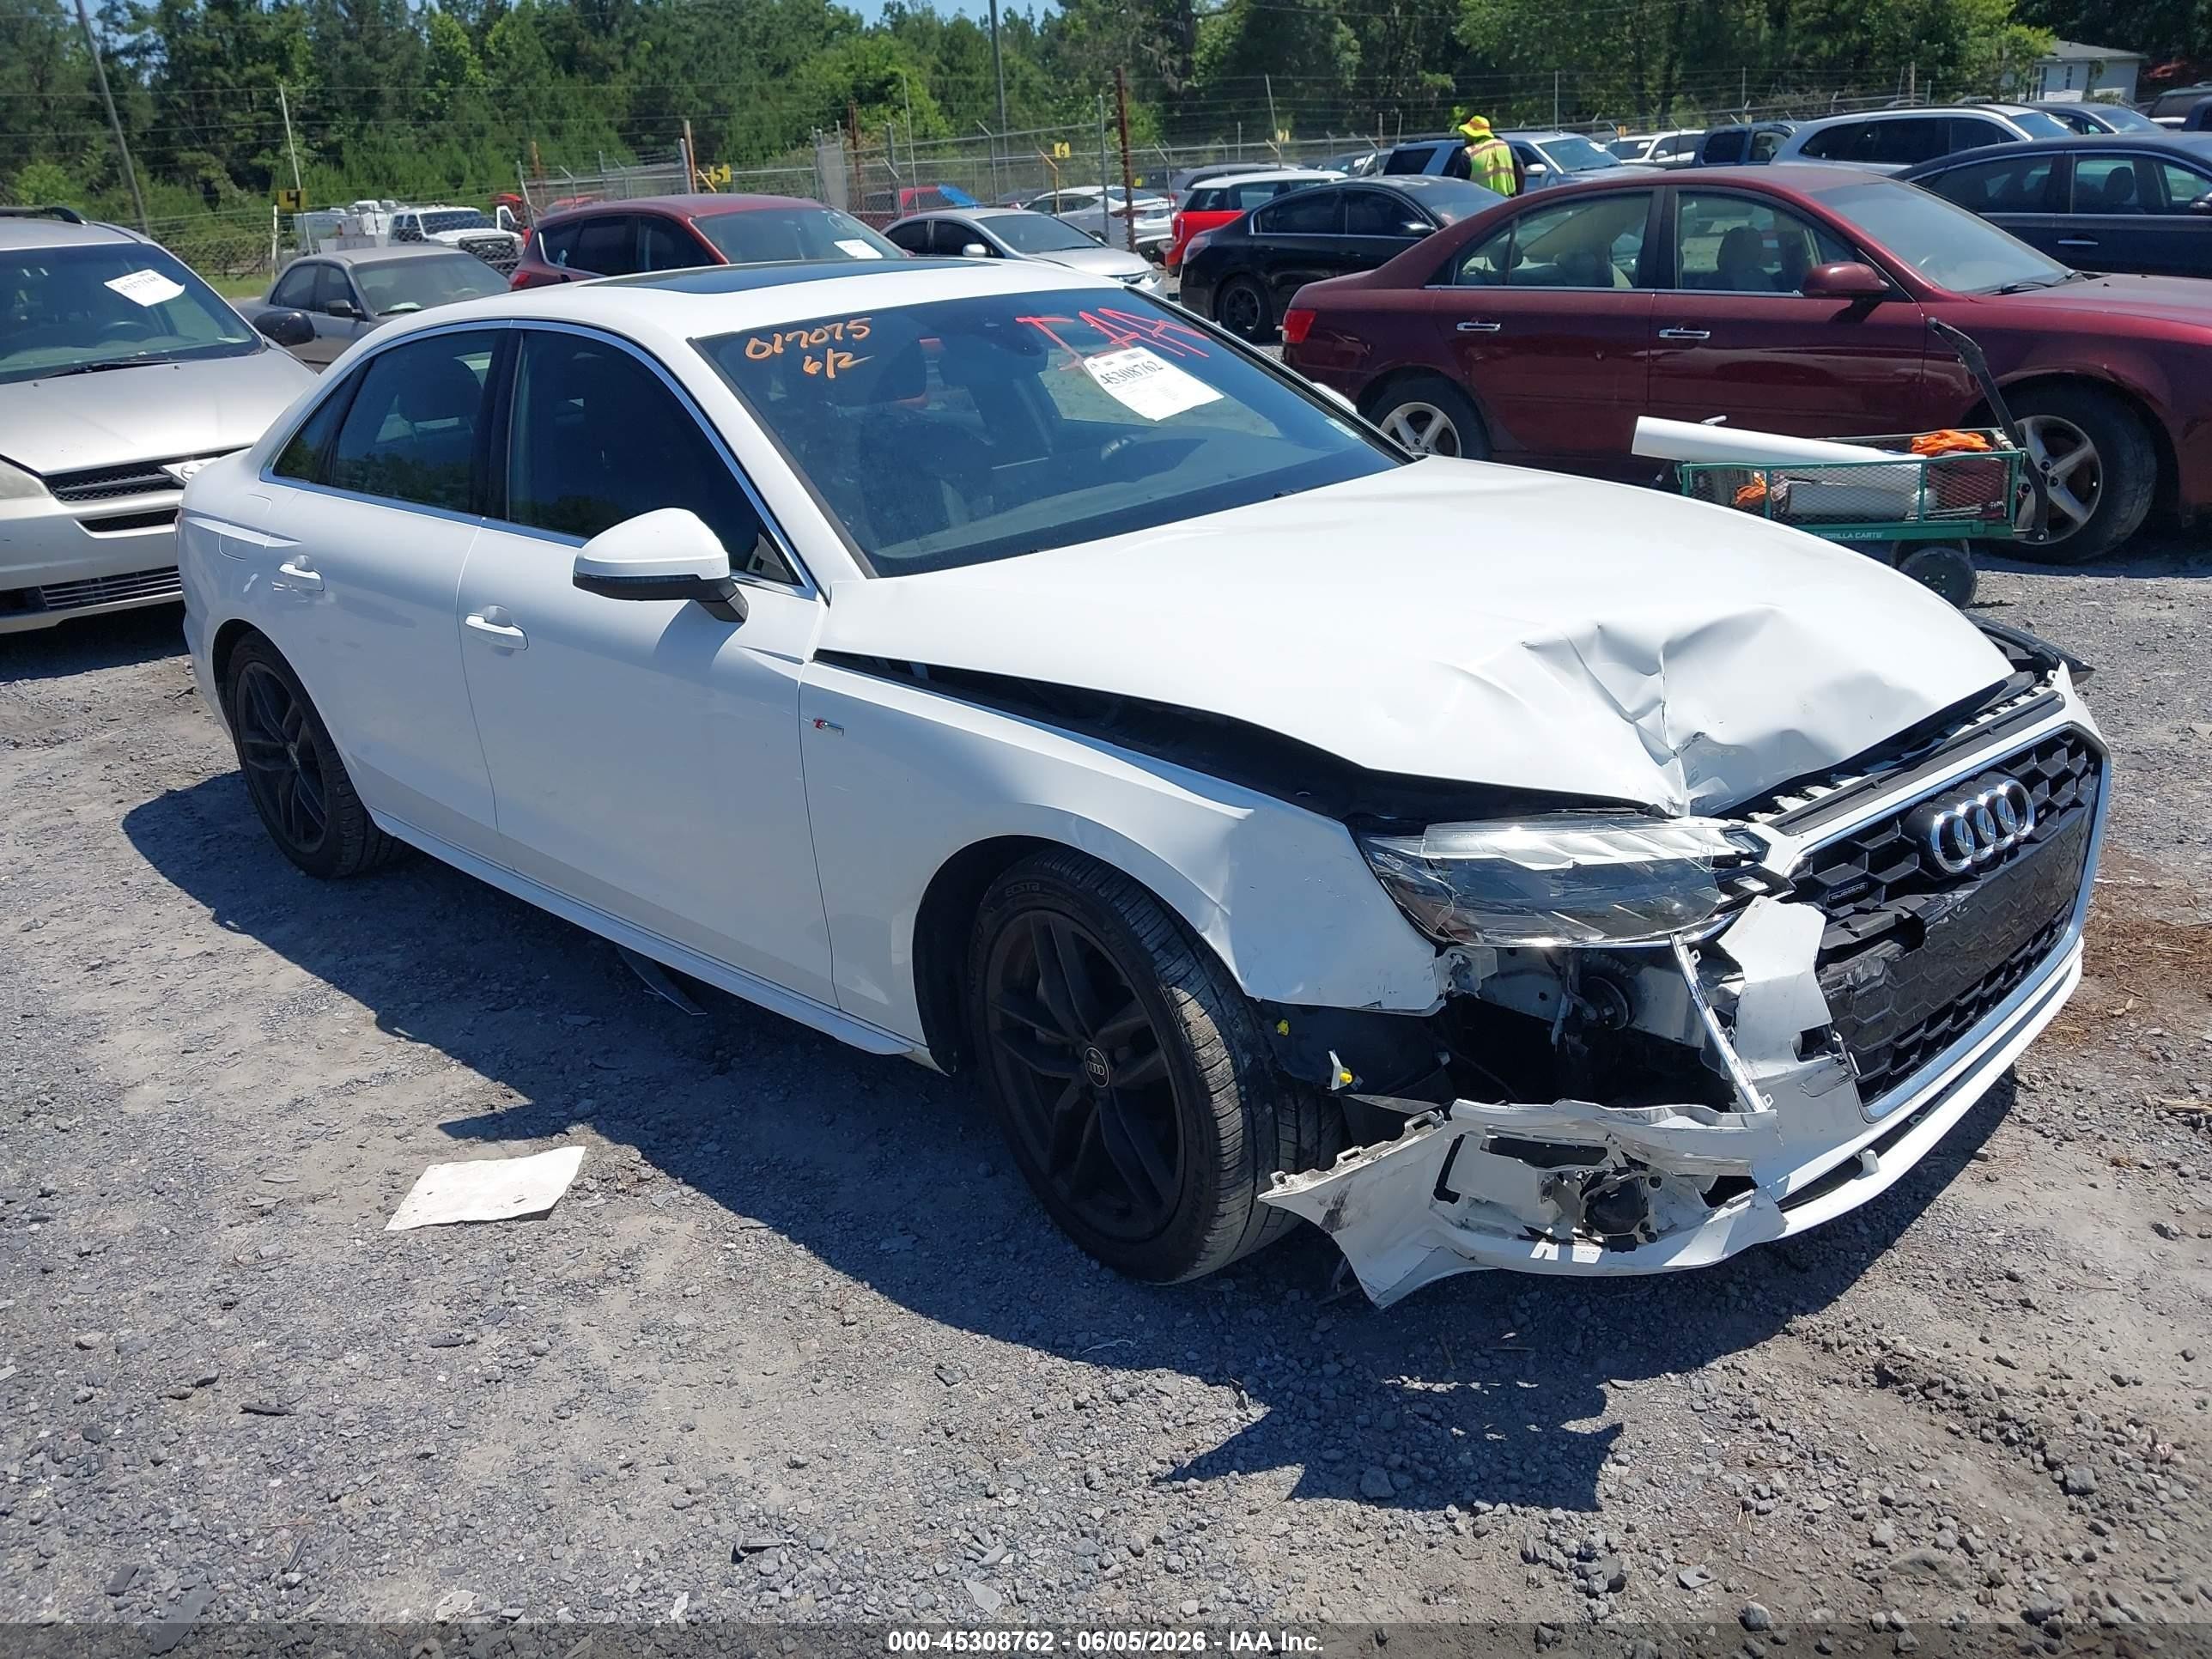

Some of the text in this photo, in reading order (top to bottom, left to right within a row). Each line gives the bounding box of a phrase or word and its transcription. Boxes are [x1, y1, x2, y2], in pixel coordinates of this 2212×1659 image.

[1059, 143, 1066, 156] 6
[714, 167, 724, 181] 5
[286, 191, 301, 208] 4
[744, 317, 873, 361] 017075
[803, 348, 876, 380] 6/2
[1098, 360, 1164, 386] 45308762
